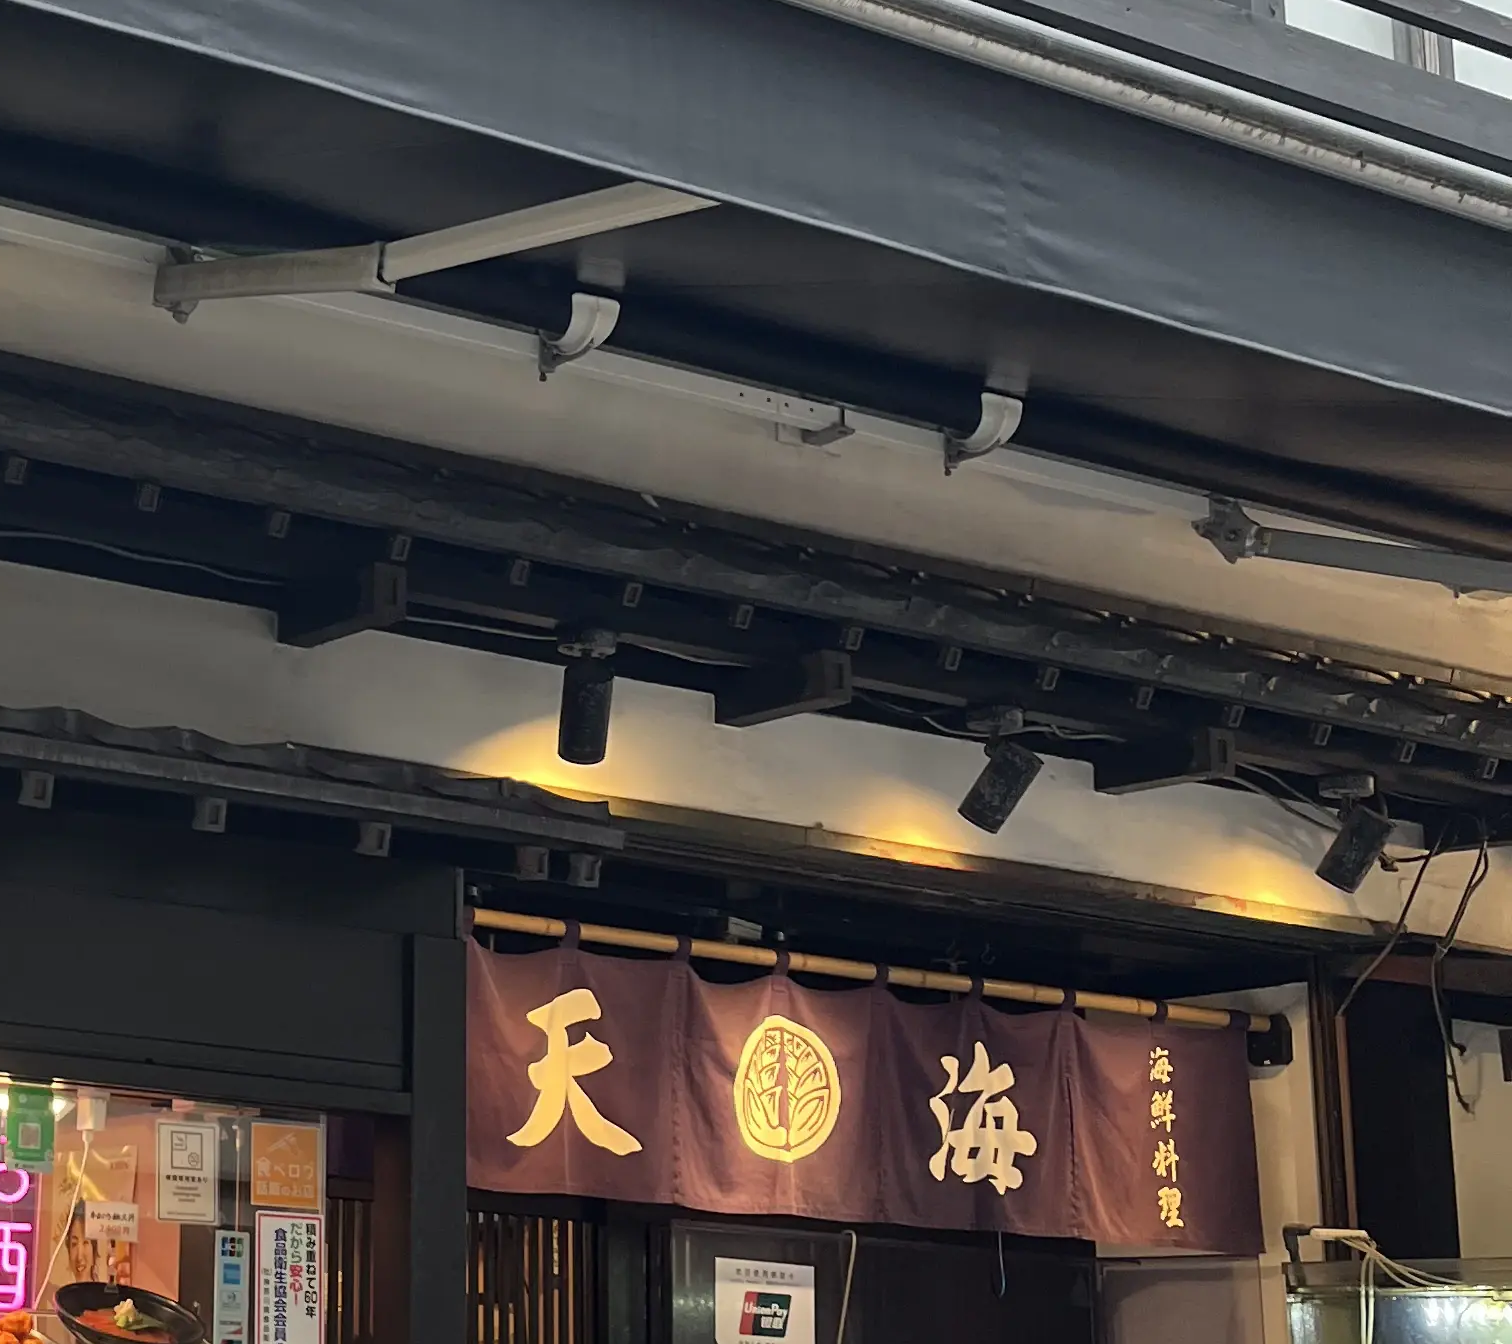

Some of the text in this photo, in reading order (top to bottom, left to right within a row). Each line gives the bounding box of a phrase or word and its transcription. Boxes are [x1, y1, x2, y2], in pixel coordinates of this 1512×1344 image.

[506, 987, 1039, 1197] 天 海
[1148, 1045, 1186, 1230] 海鮮料理
[743, 1301, 789, 1320] UnionPay
